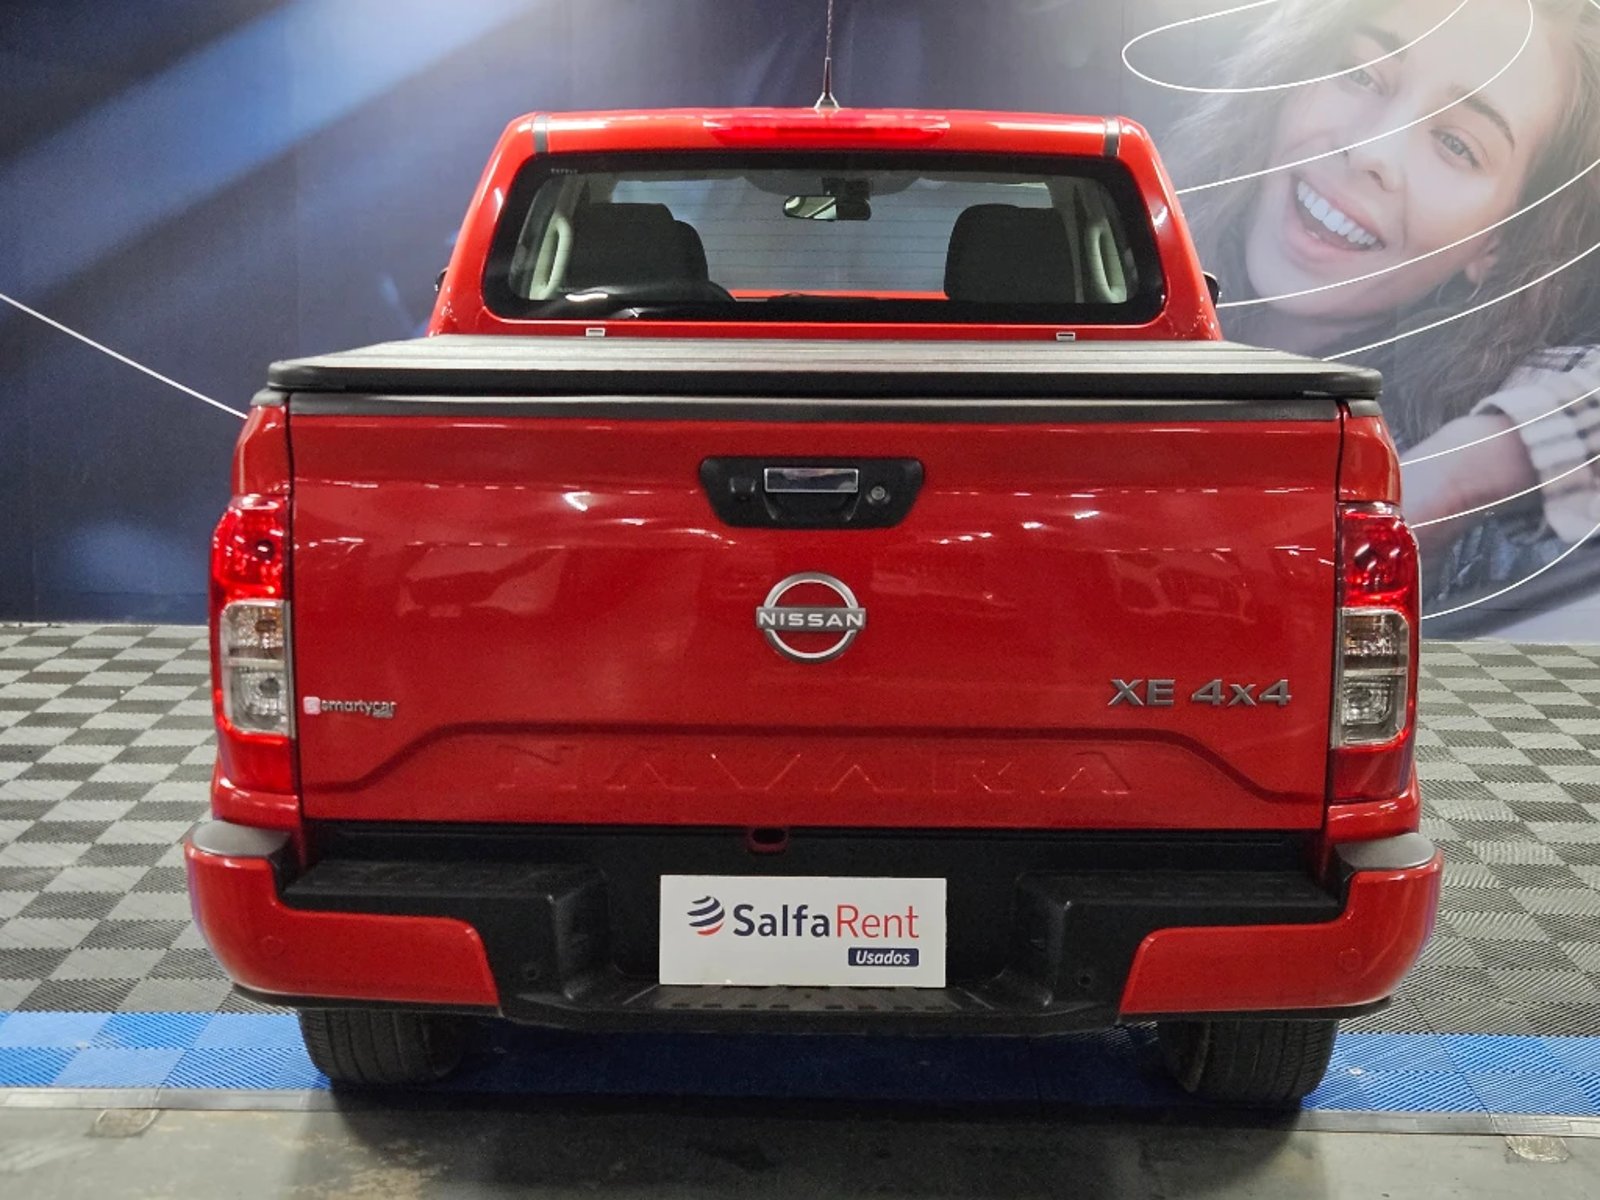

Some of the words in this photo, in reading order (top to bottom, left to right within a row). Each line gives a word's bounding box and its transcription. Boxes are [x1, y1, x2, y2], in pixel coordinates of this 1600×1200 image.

[759, 611, 863, 627] NISSAN
[1107, 679, 1176, 706] XE
[1191, 679, 1292, 706] 4x4
[496, 745, 1132, 794] NAVARA
[733, 903, 919, 938] SalfaRent
[855, 950, 911, 965] Usados
